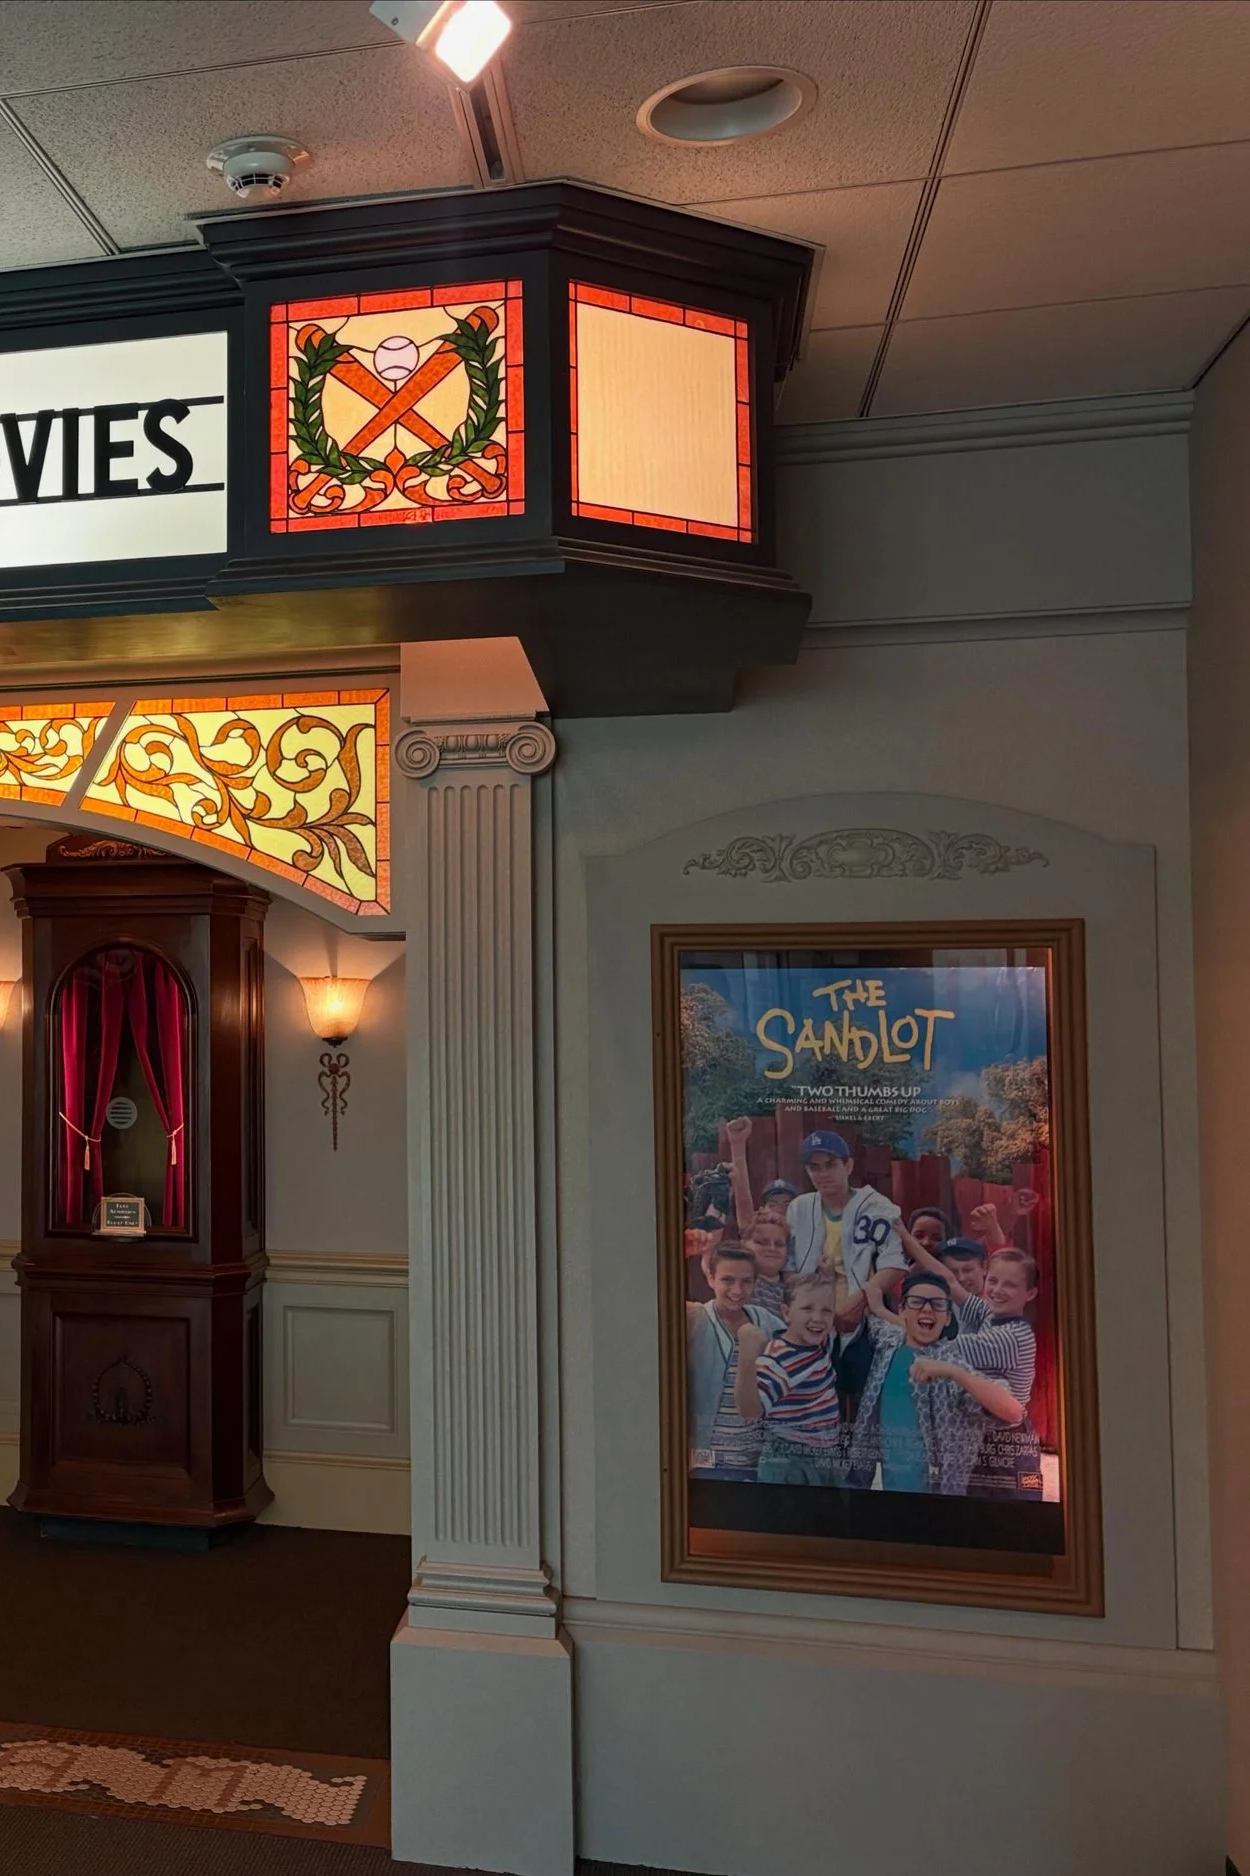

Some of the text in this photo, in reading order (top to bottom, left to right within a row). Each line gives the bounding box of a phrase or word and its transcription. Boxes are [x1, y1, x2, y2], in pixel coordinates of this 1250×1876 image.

[812, 979, 887, 1012] THE
[756, 1008, 956, 1080] SANDLOT
[835, 1086, 899, 1097] THUMBS
[902, 1086, 921, 1097] UP
[853, 1215, 891, 1246] 30
